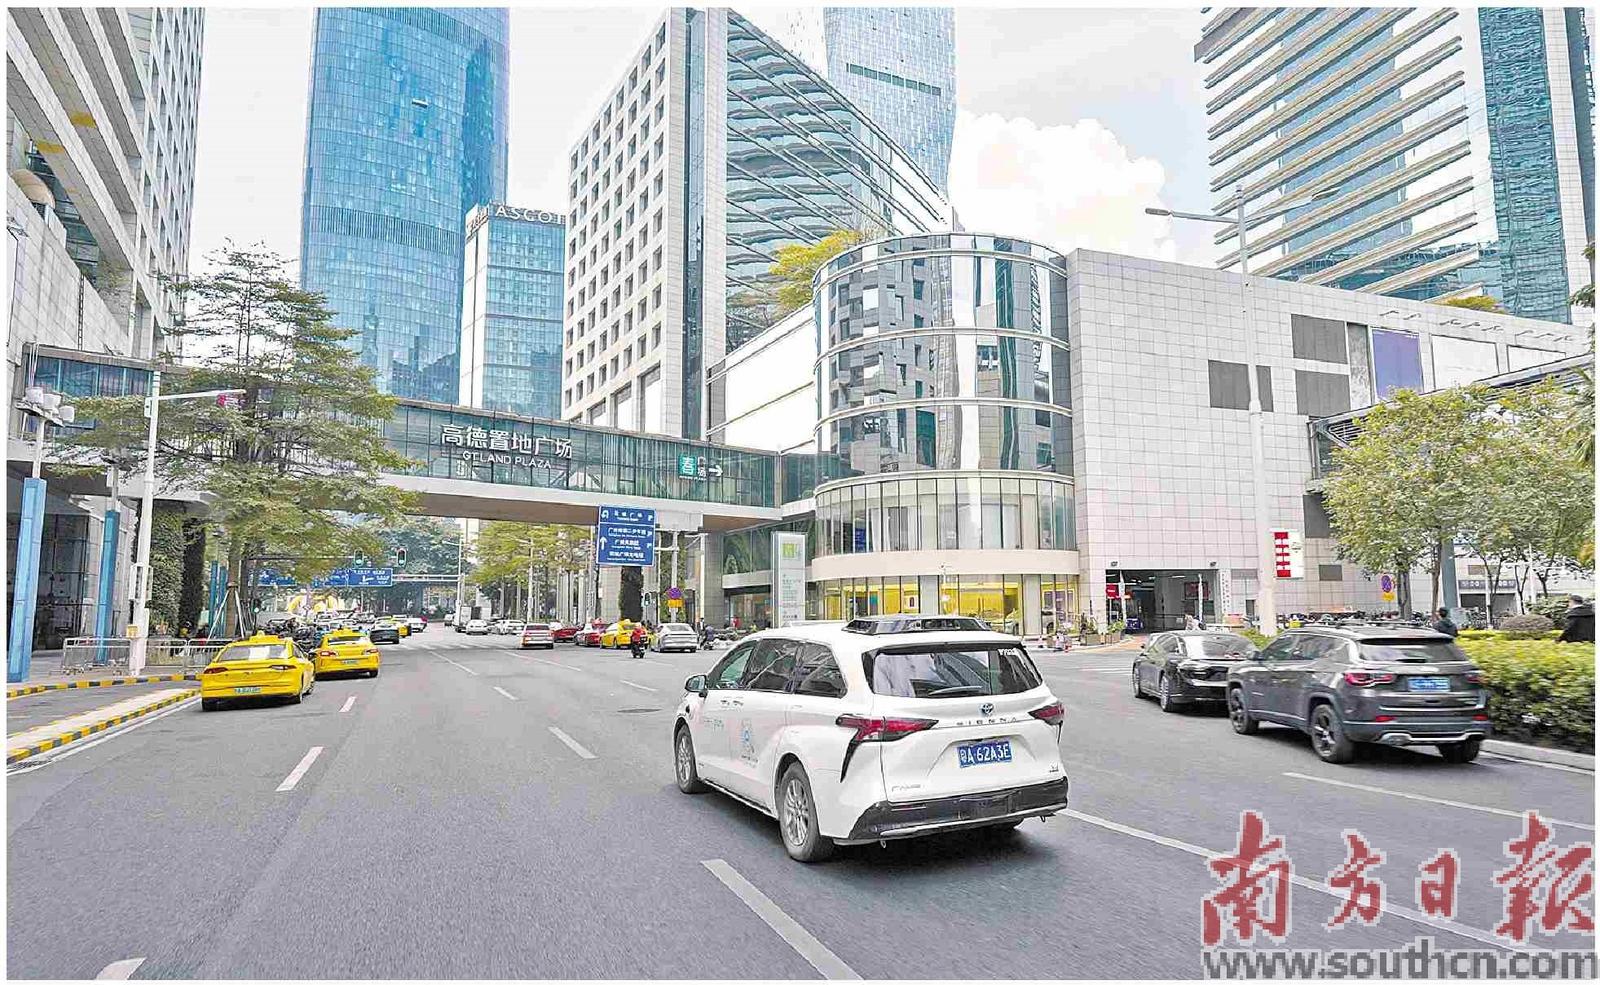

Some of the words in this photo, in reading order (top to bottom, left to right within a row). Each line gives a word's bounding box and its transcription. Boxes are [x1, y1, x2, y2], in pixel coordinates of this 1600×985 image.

[441, 424, 573, 459] 高德置地广场
[514, 456, 552, 469] PLAZA
